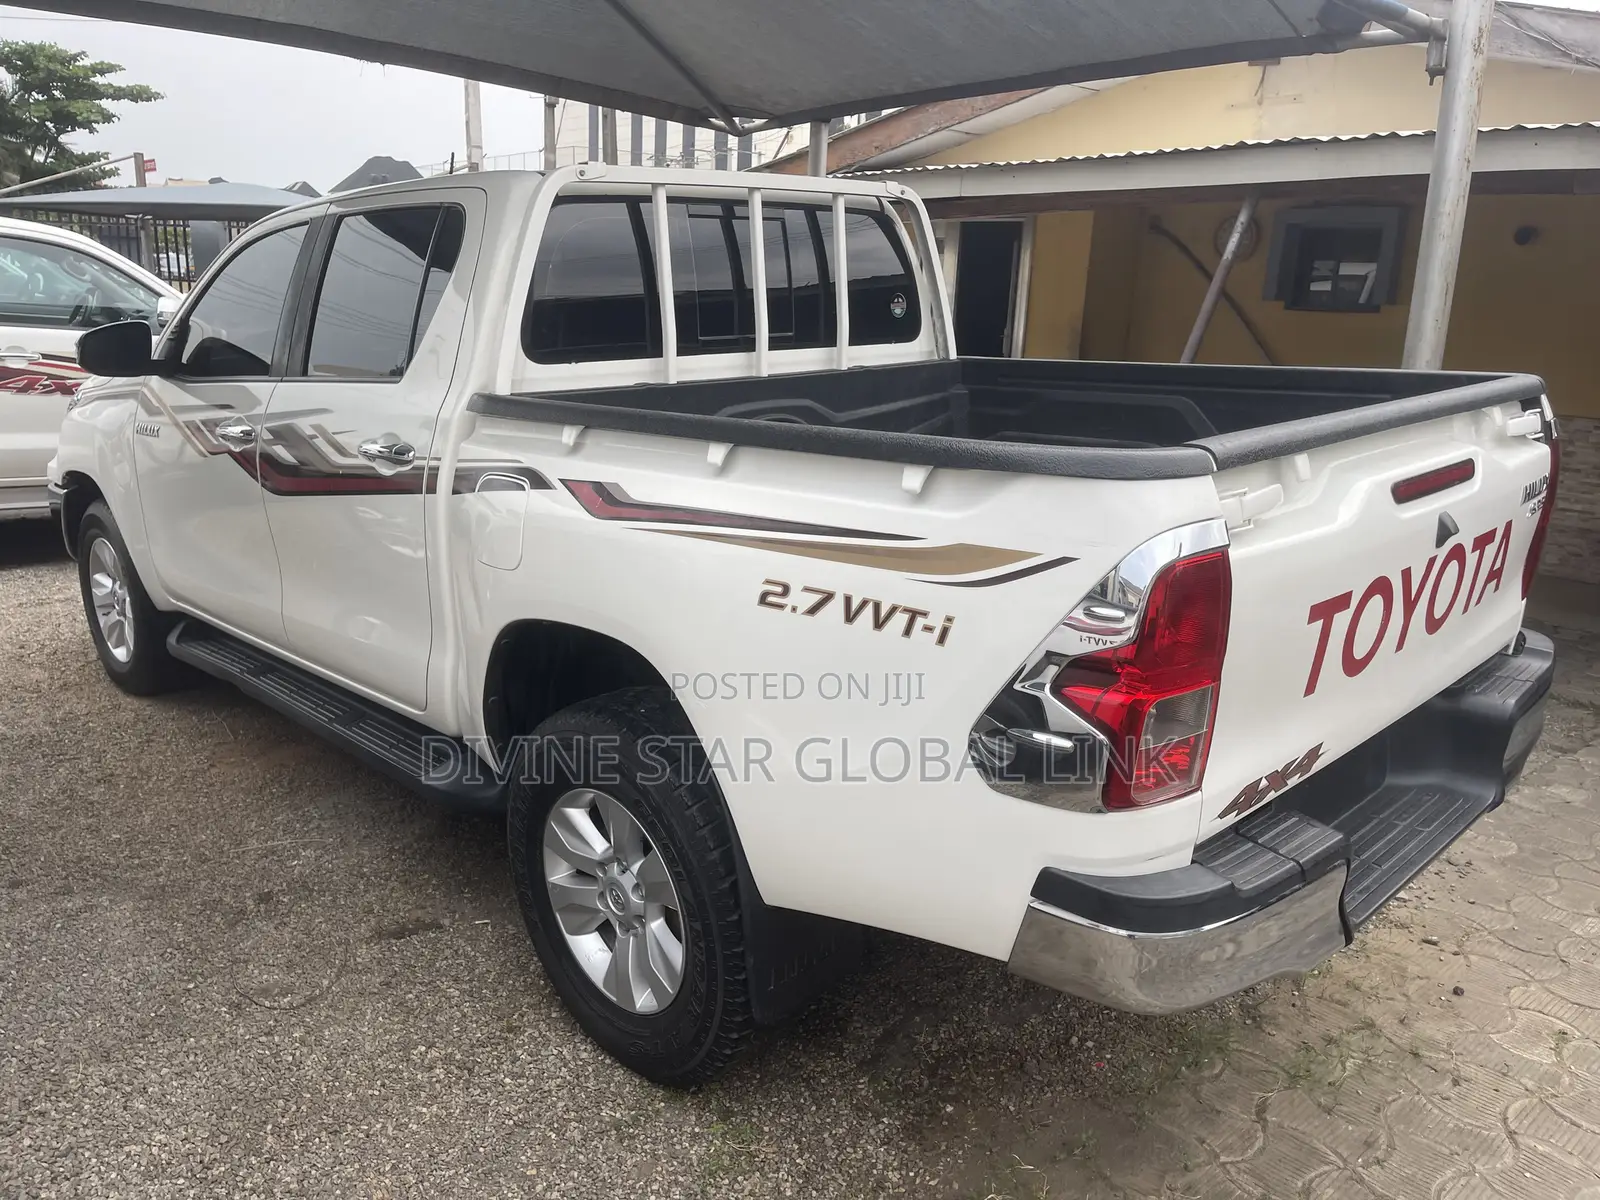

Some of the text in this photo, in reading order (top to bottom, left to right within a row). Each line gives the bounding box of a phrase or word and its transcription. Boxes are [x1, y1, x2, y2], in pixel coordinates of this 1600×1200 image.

[136, 421, 161, 438] HILUX
[757, 578, 955, 647] 2.7 VVT-i
[1302, 519, 1513, 698] TOYOTA
